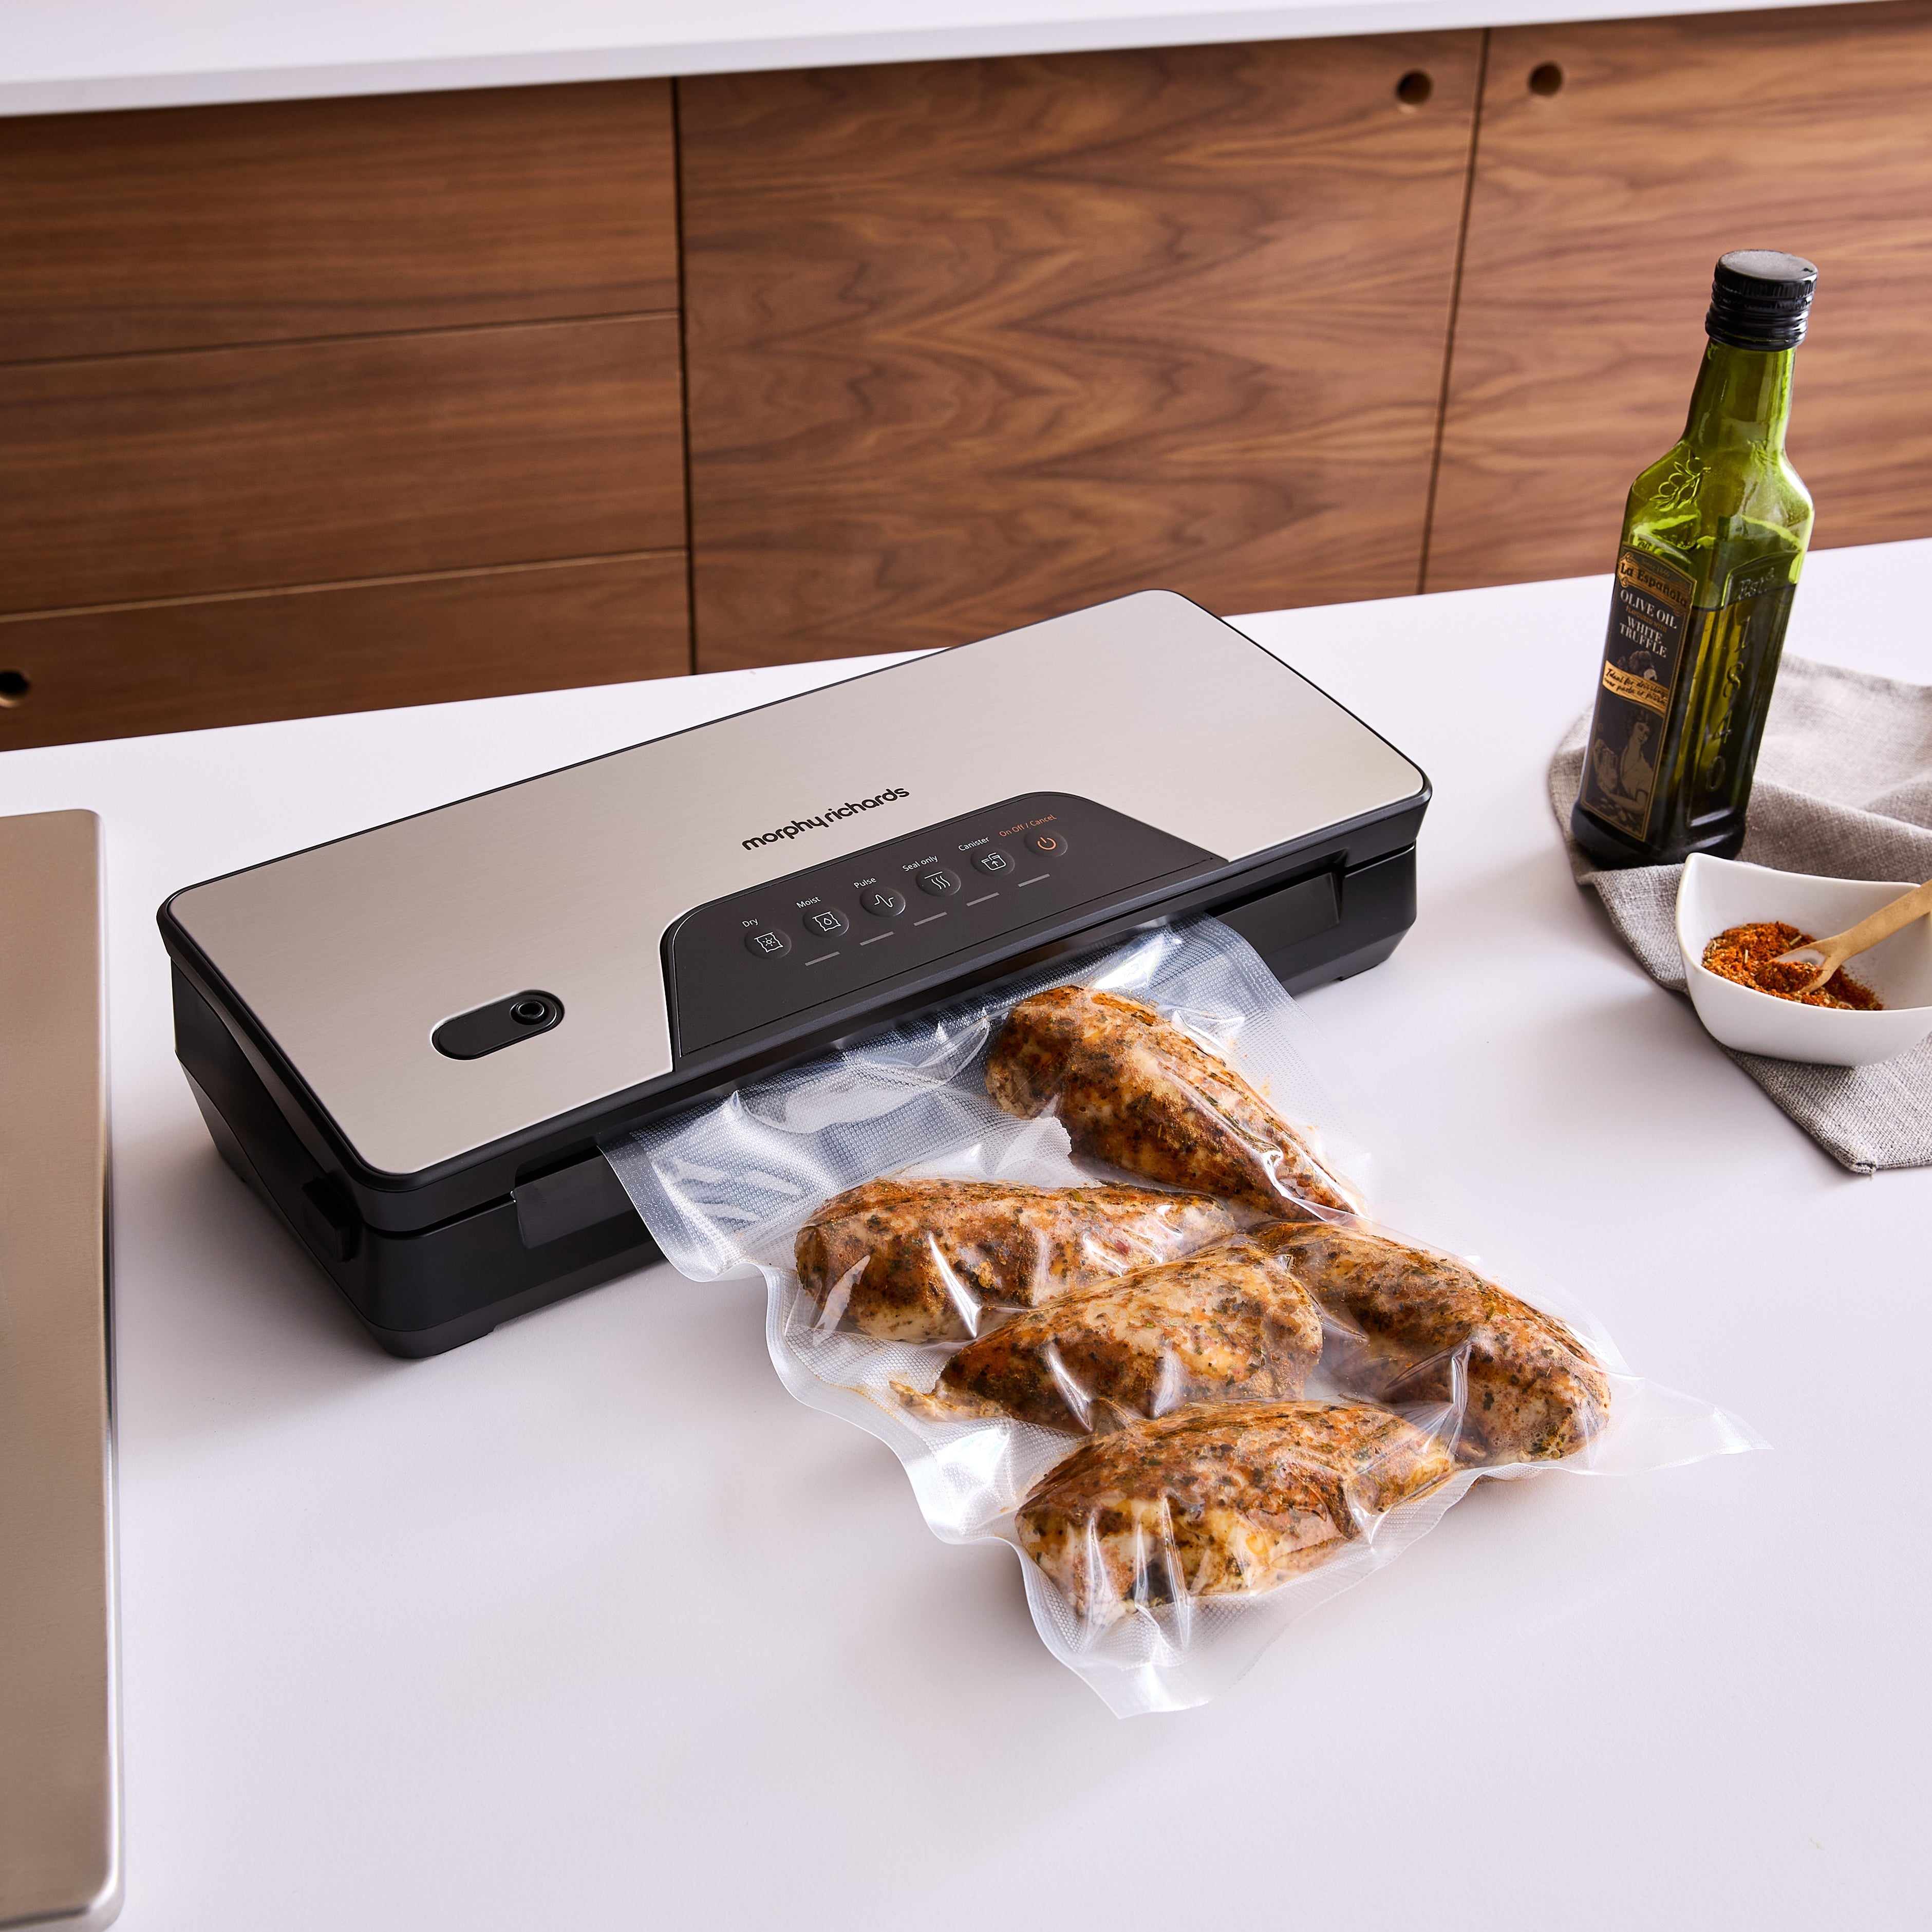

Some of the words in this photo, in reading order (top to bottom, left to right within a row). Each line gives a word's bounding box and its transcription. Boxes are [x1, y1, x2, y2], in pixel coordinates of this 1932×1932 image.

[1620, 563, 1634, 576] La
[1620, 589, 1655, 616] OLIVE
[1656, 609, 1677, 629] OIL
[1627, 615, 1663, 644] WHITE
[1619, 622, 1667, 658] TRUFFLE
[742, 816, 829, 850] morphy
[824, 788, 909, 822] richards
[999, 829, 1012, 837] On
[1011, 823, 1025, 833] Off
[1029, 814, 1057, 827] Cancel
[958, 836, 989, 852] Canister
[902, 857, 920, 872] Seal
[921, 854, 939, 866] only
[853, 877, 877, 889] Pulse
[796, 896, 821, 908] Moist
[742, 918, 758, 928] Dry
